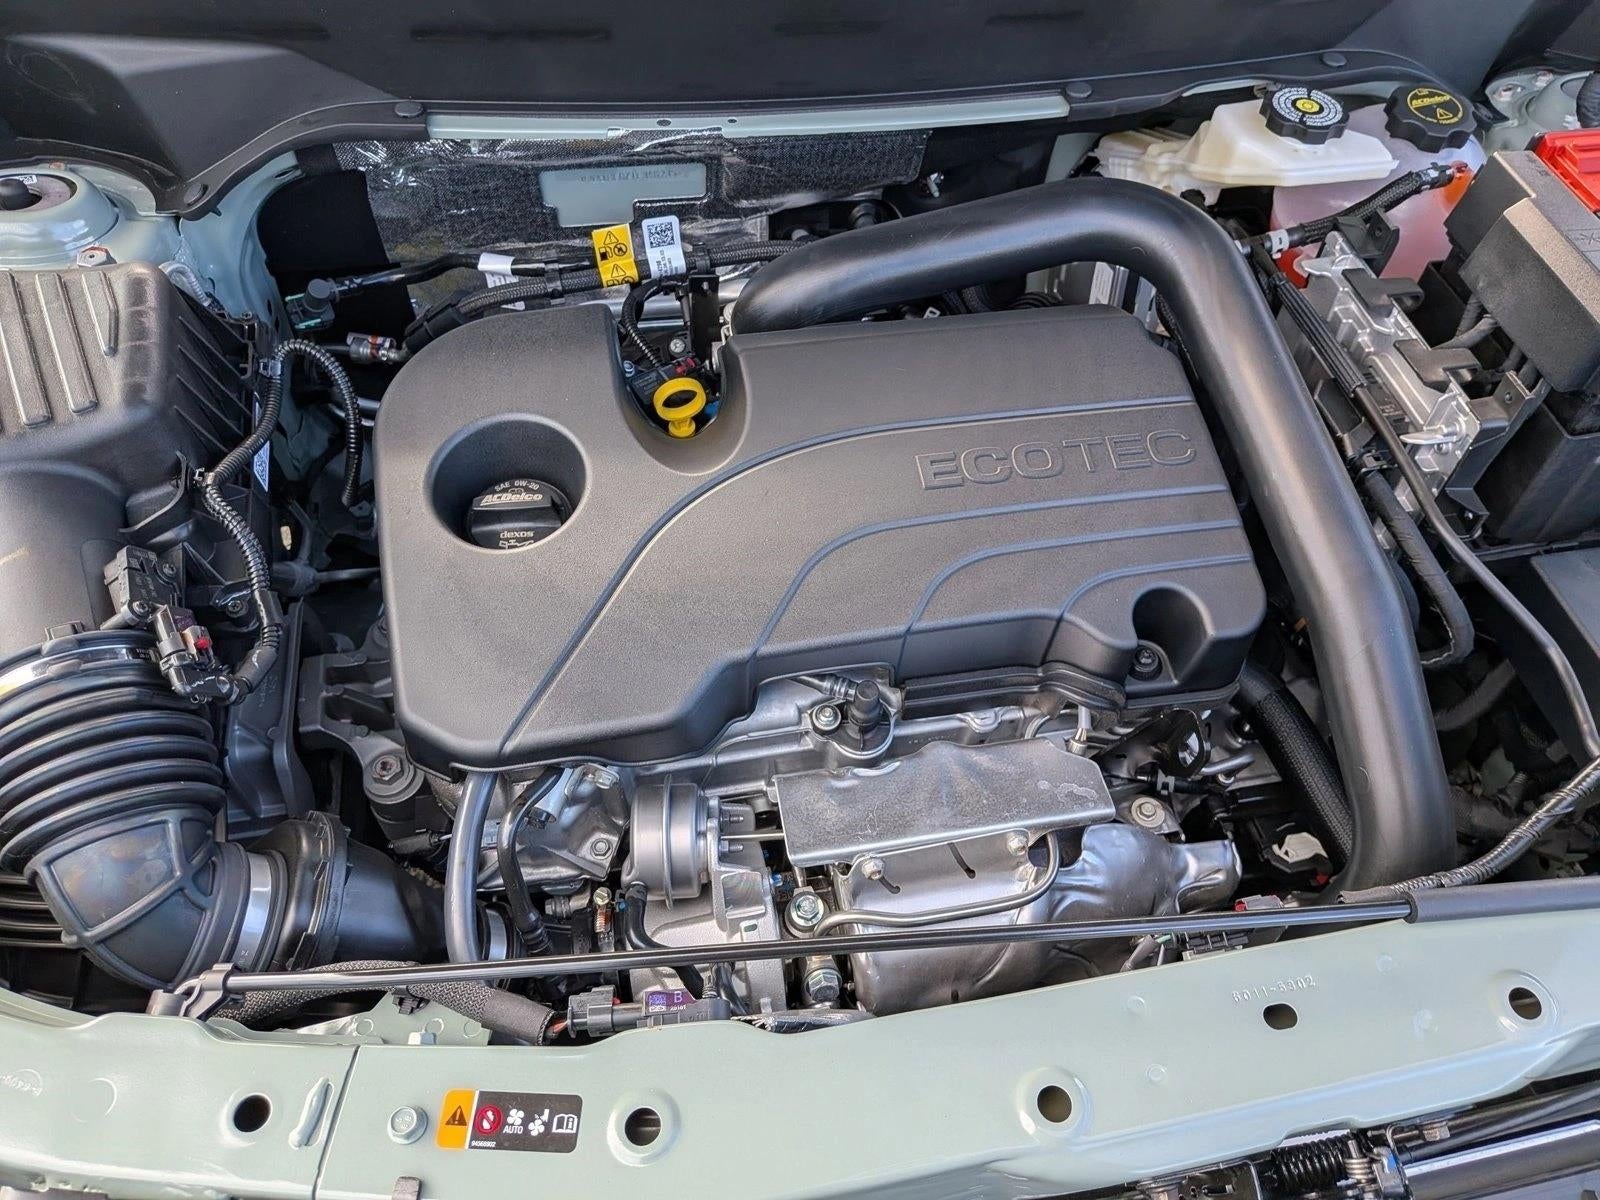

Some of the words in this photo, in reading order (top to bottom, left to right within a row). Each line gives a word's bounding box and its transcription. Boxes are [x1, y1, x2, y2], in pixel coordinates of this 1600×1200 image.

[915, 429, 1196, 490] ECOTEC
[494, 481, 511, 492] SAE
[514, 479, 540, 491] 0W-20
[480, 492, 543, 506] ACDelco
[499, 530, 535, 539] dexos
[674, 990, 683, 1003] B
[502, 1125, 524, 1134] AUTO
